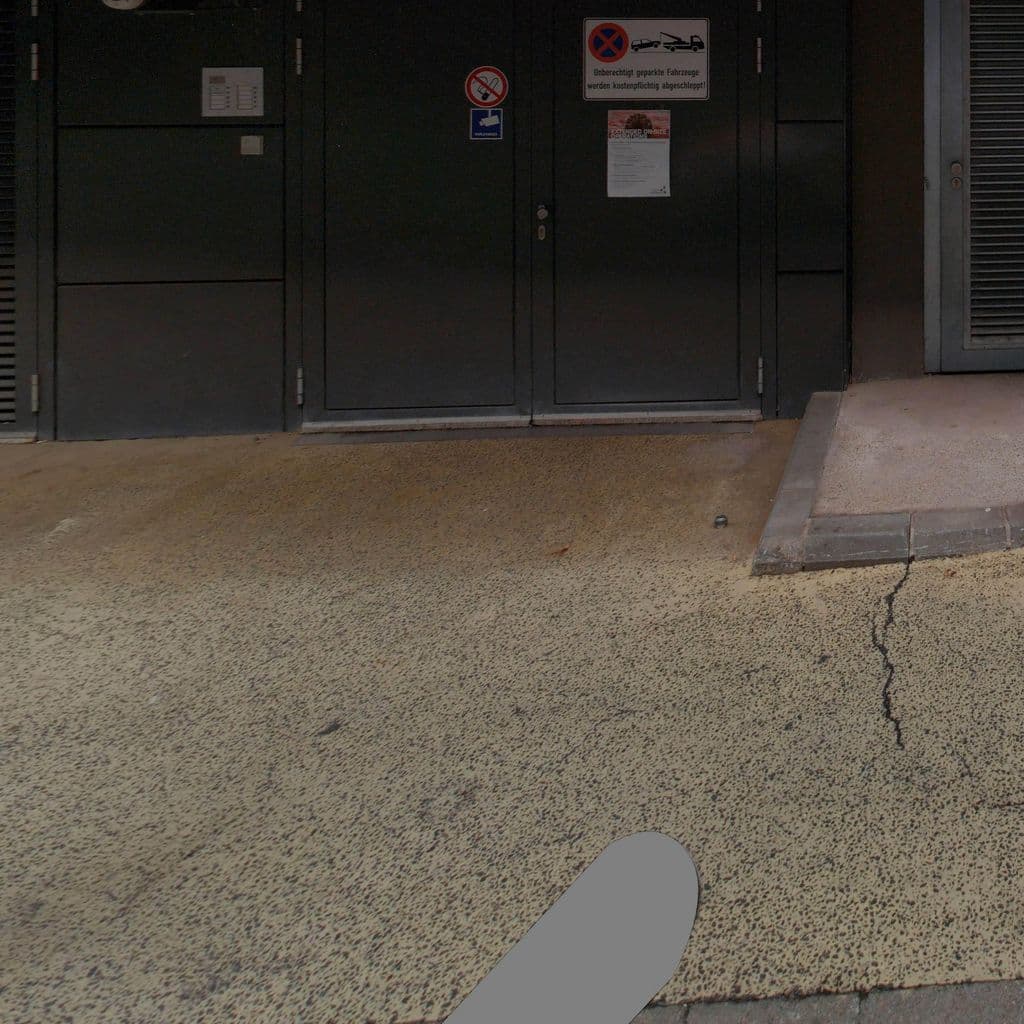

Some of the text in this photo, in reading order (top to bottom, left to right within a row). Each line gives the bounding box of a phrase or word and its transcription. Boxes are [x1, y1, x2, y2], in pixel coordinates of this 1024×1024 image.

[593, 68, 700, 78] Unberechtigt geparkte Fahrzeuge
[587, 81, 706, 91] werden kostenpflichtig abgeschleppt!
